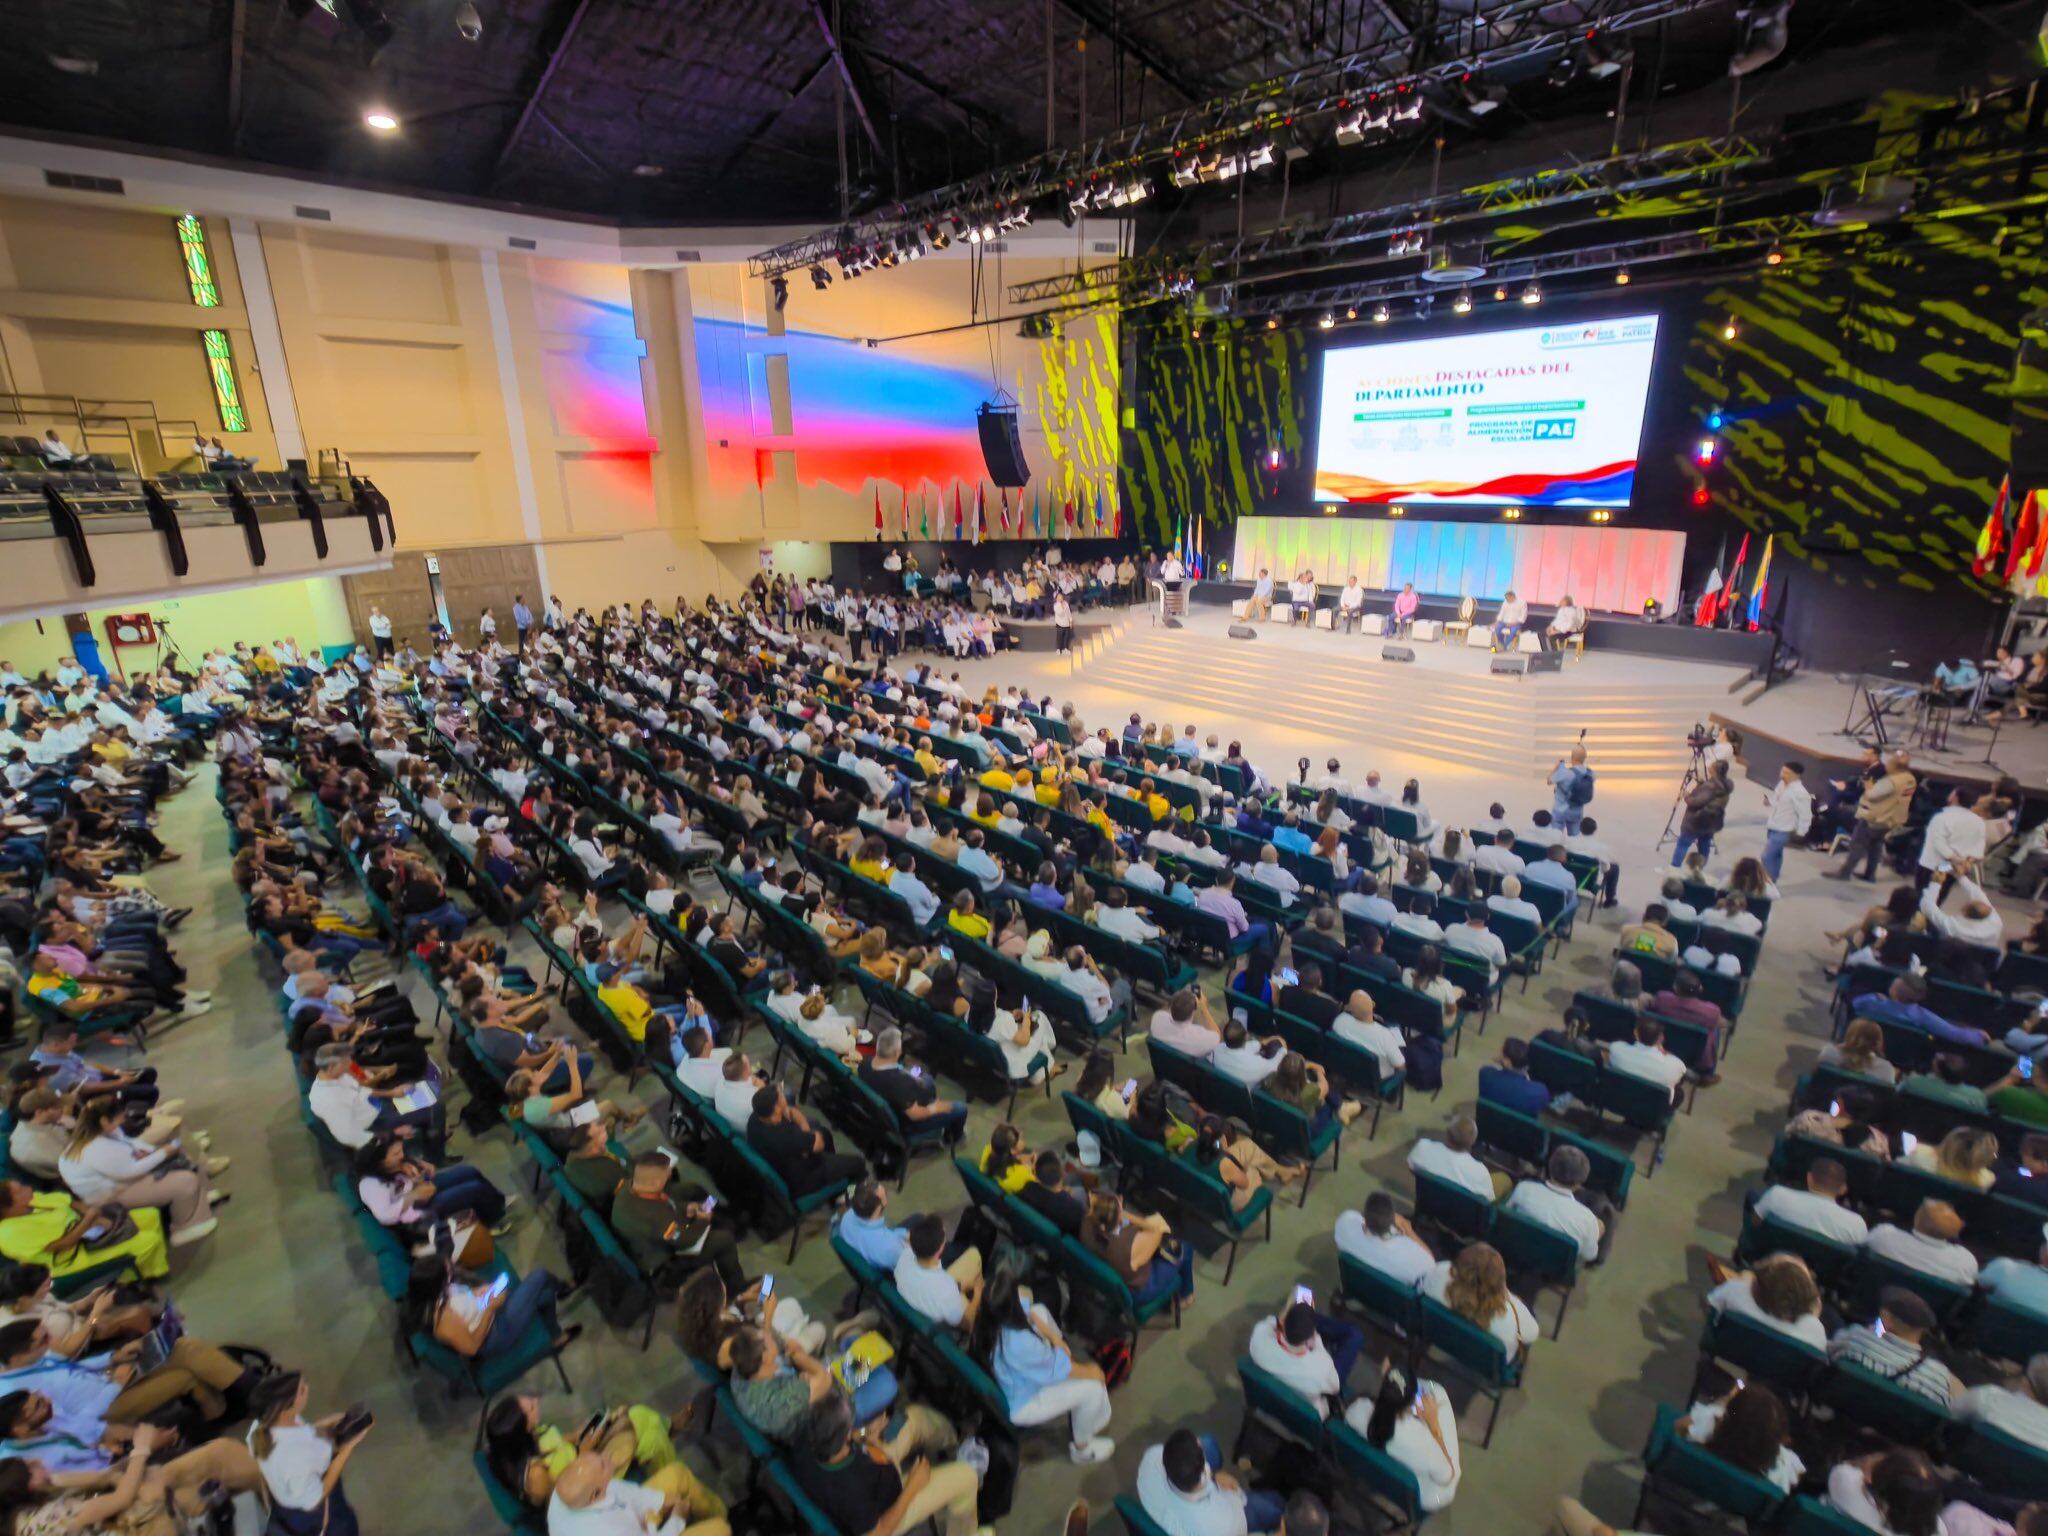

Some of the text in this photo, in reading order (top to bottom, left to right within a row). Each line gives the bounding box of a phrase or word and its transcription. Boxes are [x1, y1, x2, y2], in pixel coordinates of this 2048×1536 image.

[1435, 365, 1537, 382] DESTACADAS
[1541, 362, 1573, 375] DEL
[1355, 383, 1484, 402] DEPARTAMENTO
[1469, 420, 1518, 428] PROGRAMA
[1535, 422, 1574, 438] PAE
